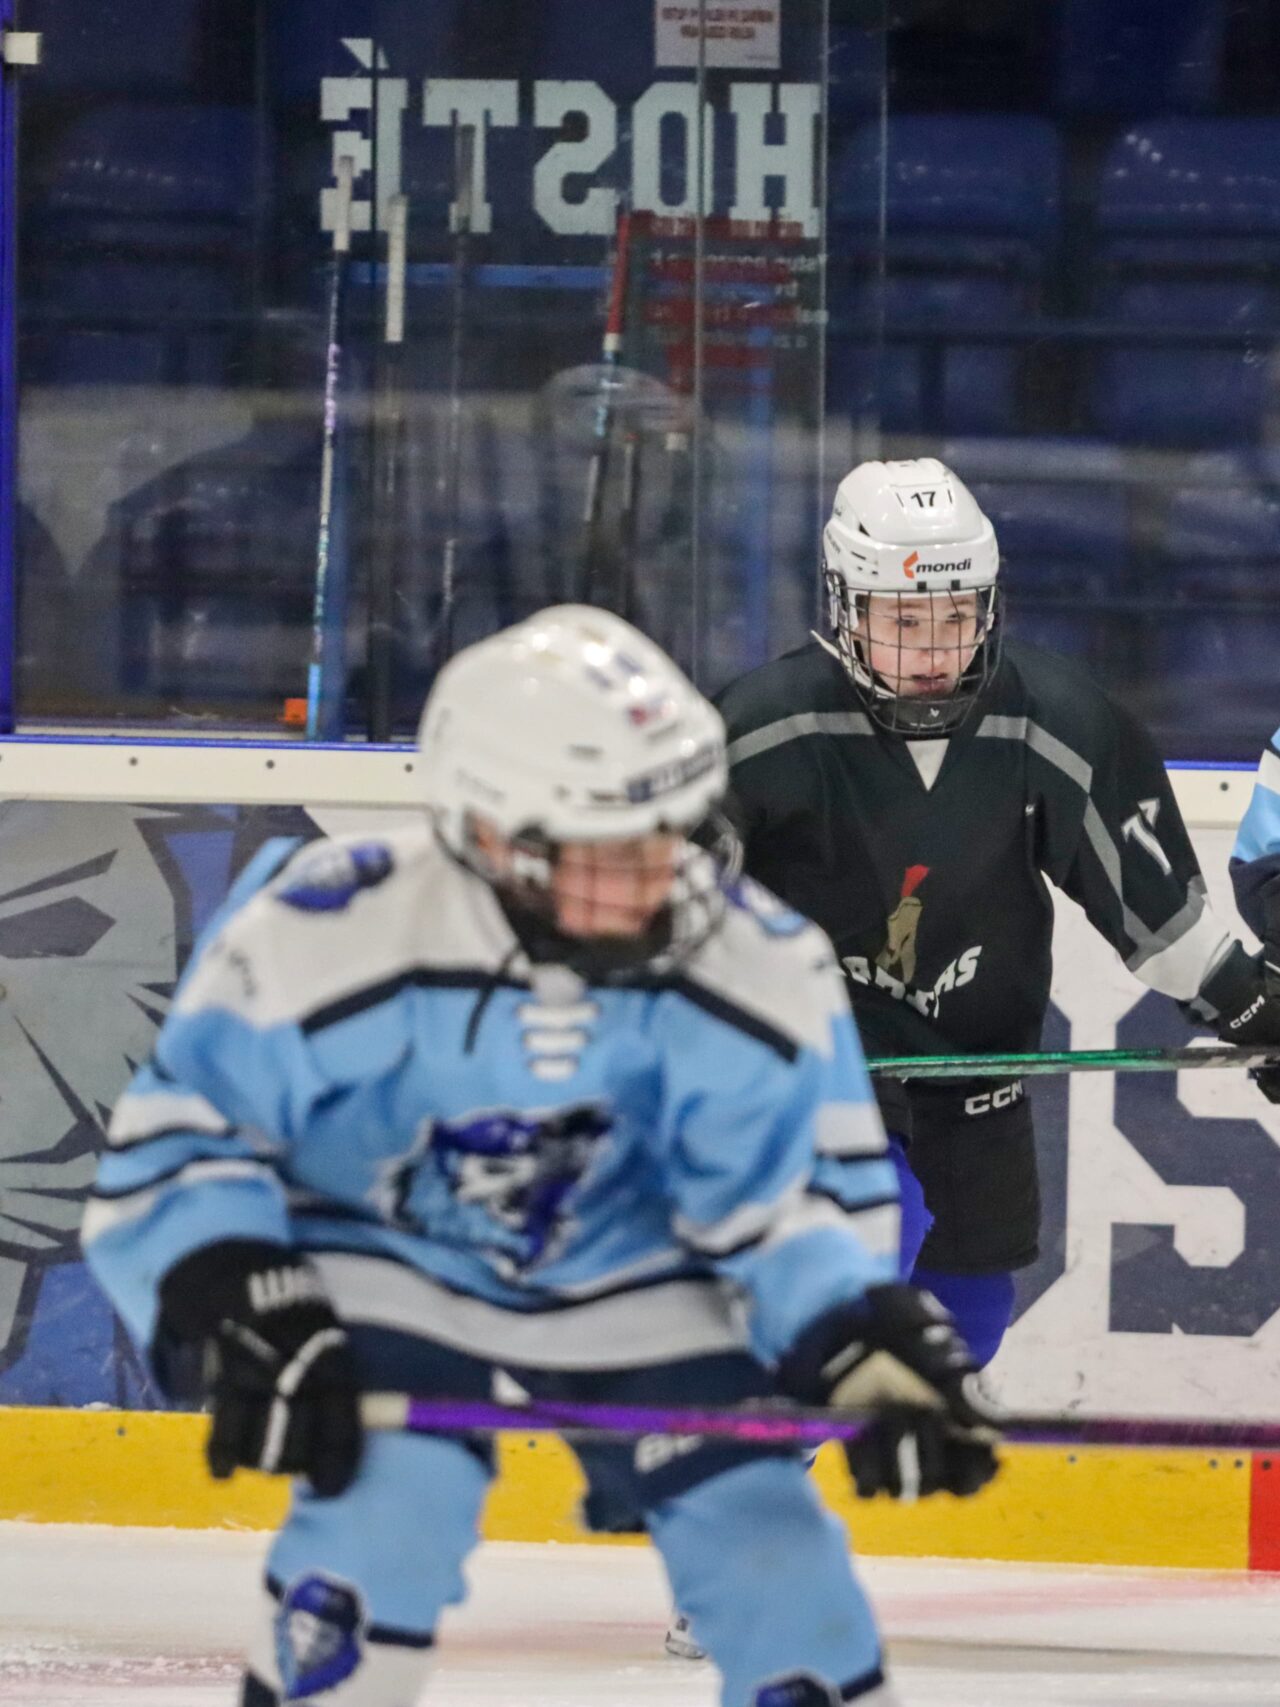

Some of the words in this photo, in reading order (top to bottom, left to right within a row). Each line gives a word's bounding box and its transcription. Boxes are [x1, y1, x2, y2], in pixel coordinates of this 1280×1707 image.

[910, 490, 937, 508] 17
[915, 557, 972, 574] mondi
[1229, 994, 1266, 1030] CCM
[963, 1079, 1025, 1116] CCM
